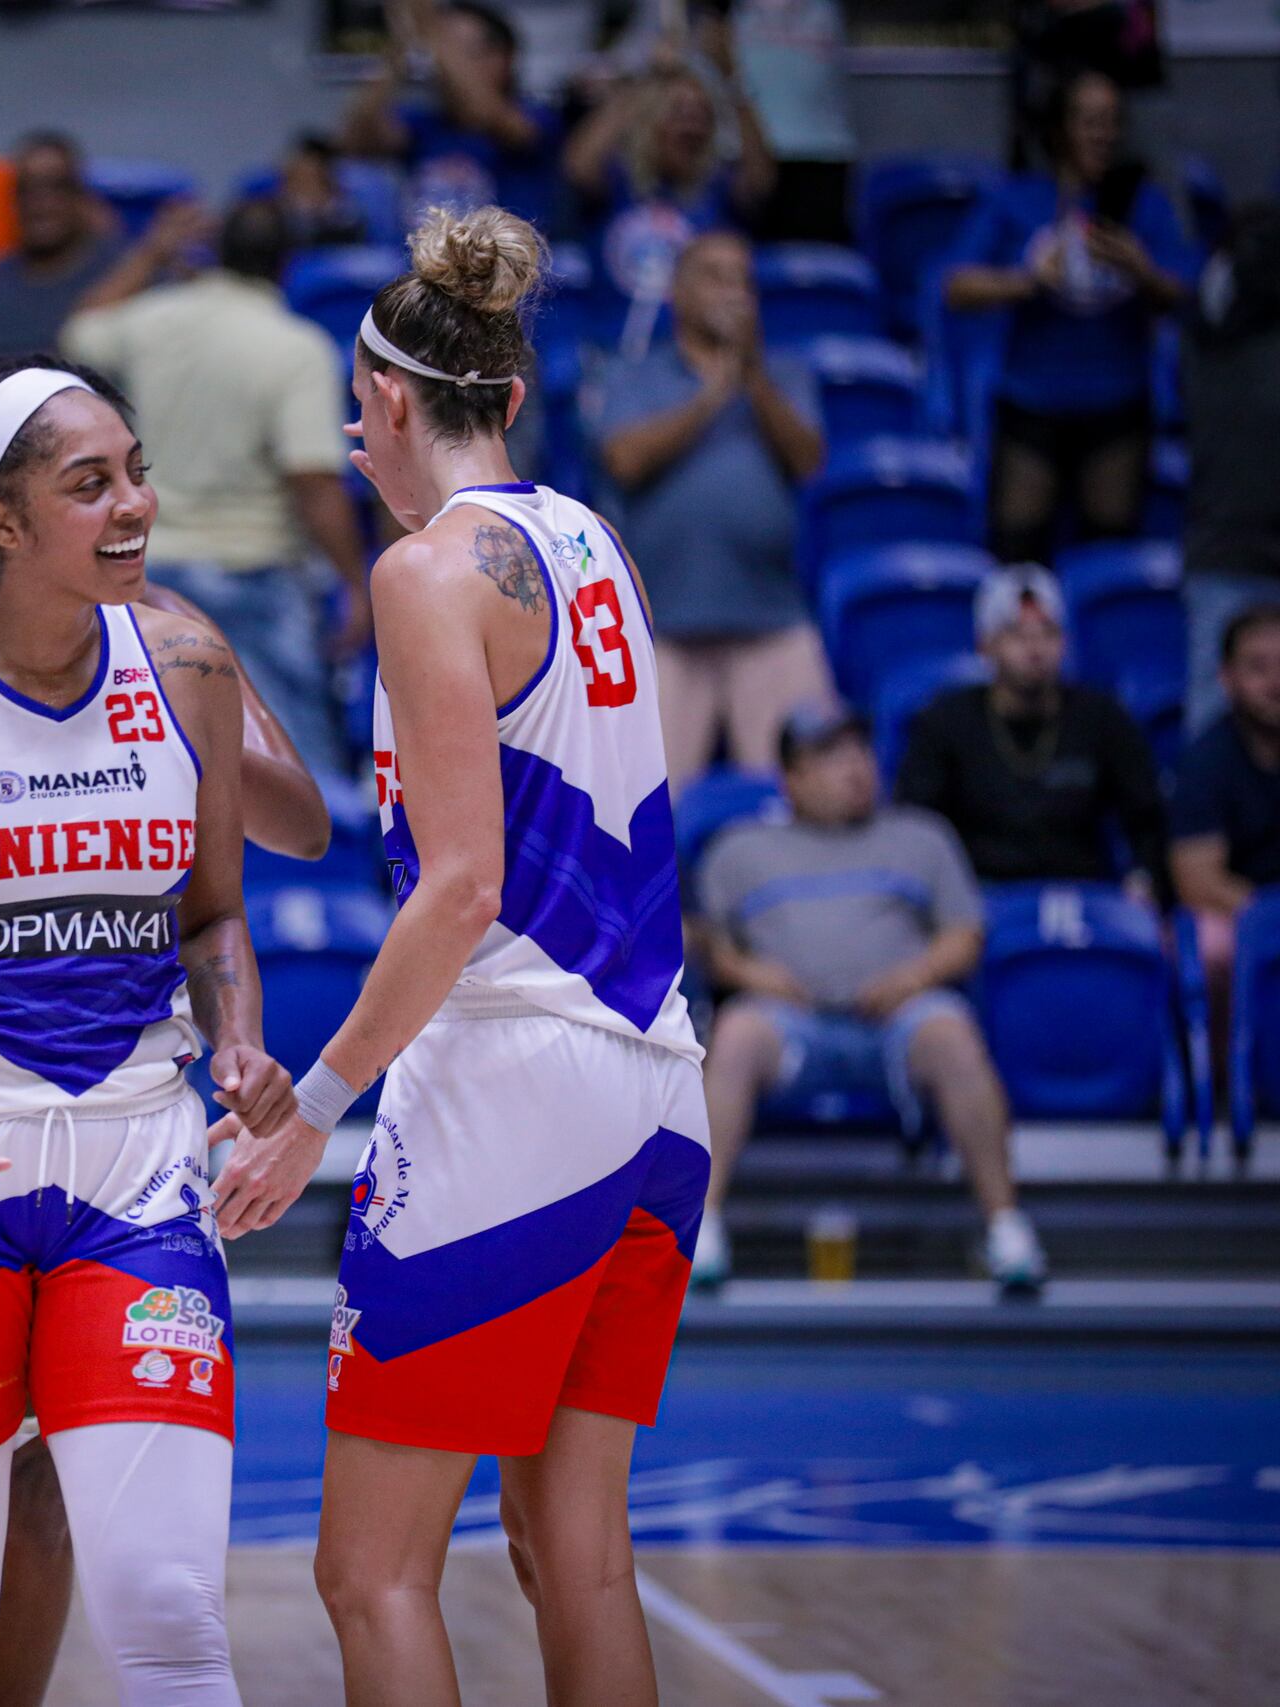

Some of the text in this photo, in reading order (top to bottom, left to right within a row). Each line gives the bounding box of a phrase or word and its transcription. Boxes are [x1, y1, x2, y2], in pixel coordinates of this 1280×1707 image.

[105, 691, 166, 744] 23
[29, 768, 131, 792] MANATI
[30, 786, 133, 799] CIUDAD DEPORTIVA
[397, 1157, 412, 1180] de
[177, 1308, 221, 1337] Soy
